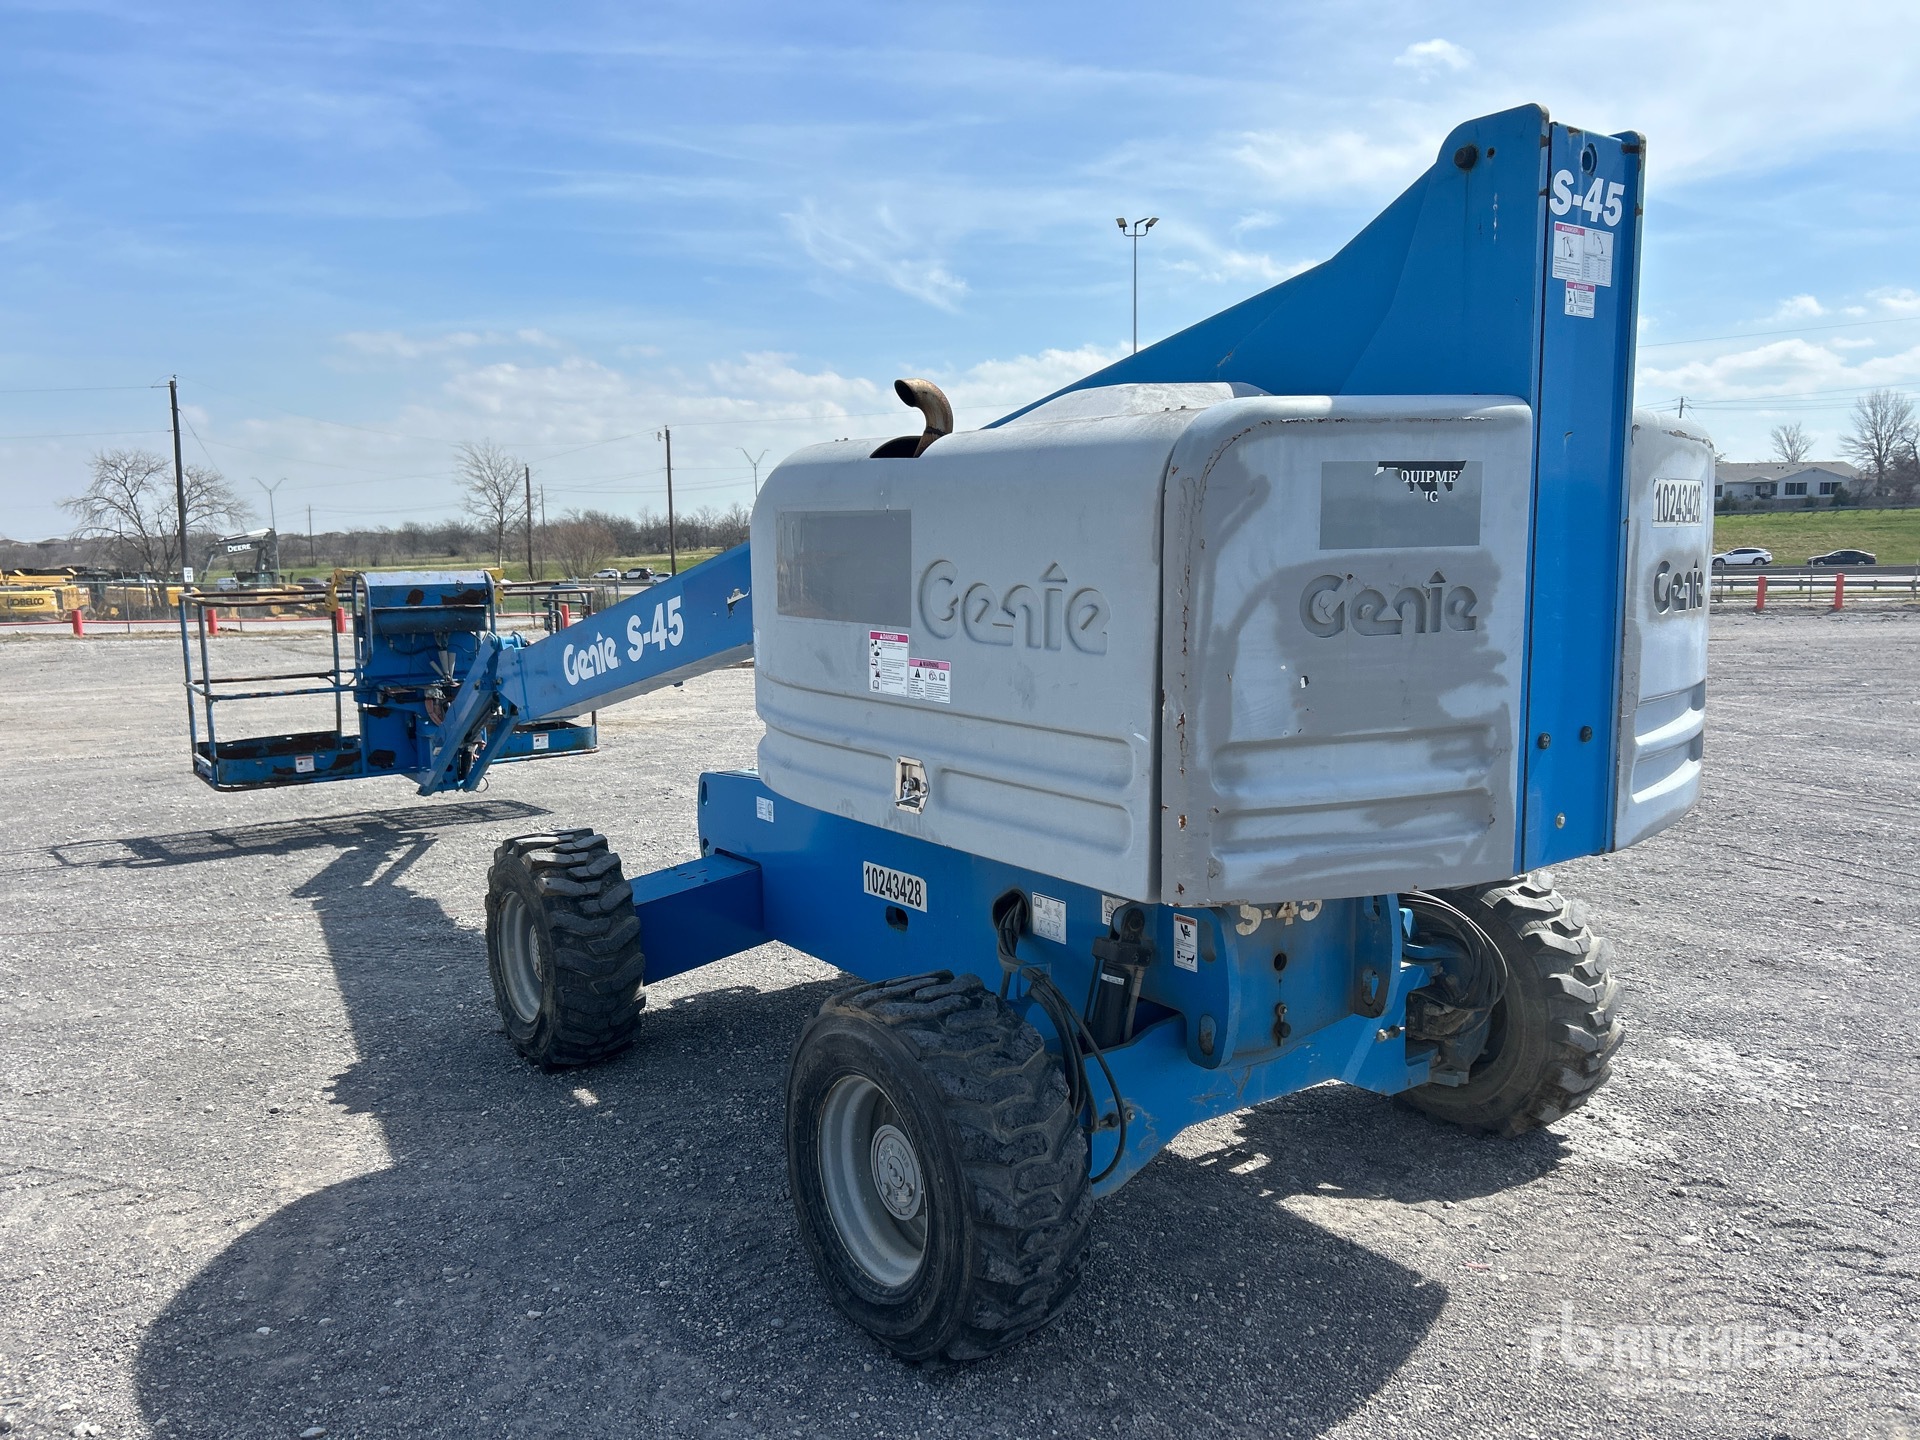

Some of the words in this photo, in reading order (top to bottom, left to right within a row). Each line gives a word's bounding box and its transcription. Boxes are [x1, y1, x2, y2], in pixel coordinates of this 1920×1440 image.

[1549, 169, 1625, 227] S-45
[1655, 484, 1701, 523] 10243428
[227, 543, 251, 553] DEERE
[919, 560, 1112, 655] Genie
[1300, 570, 1478, 638] Genie
[1653, 558, 1704, 615] Genie
[563, 631, 619, 686] Genie
[626, 595, 684, 662] S-45
[884, 633, 899, 641] DANGER
[865, 865, 923, 908] 10243428
